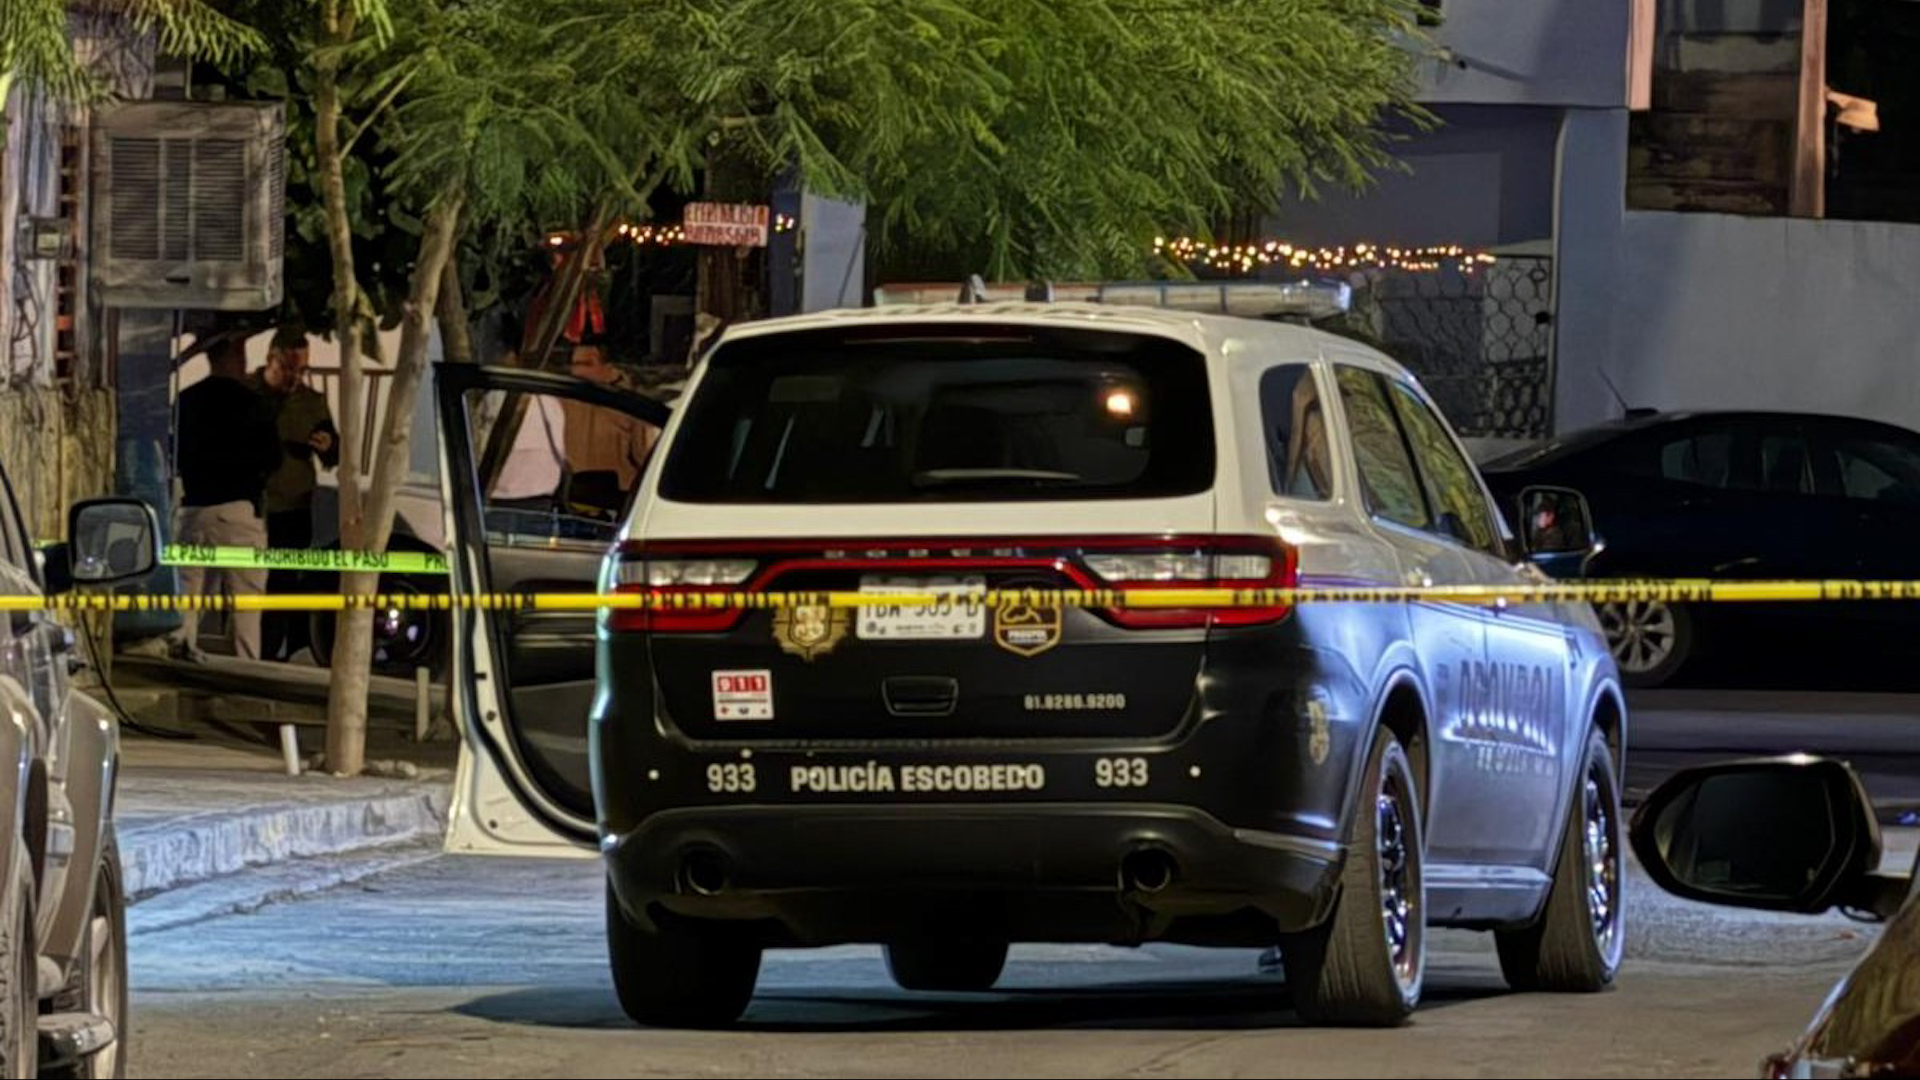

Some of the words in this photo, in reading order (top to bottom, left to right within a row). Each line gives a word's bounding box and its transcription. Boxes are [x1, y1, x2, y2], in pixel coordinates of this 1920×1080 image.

[254, 547, 330, 567] PROHIBIDO
[334, 550, 349, 567] EL
[352, 550, 390, 568] PASO
[719, 675, 765, 692] 911
[706, 763, 756, 792] 933
[790, 760, 895, 792] POLICÍA
[901, 764, 1045, 791] ESCOBEDO
[1095, 757, 1148, 787] 933
